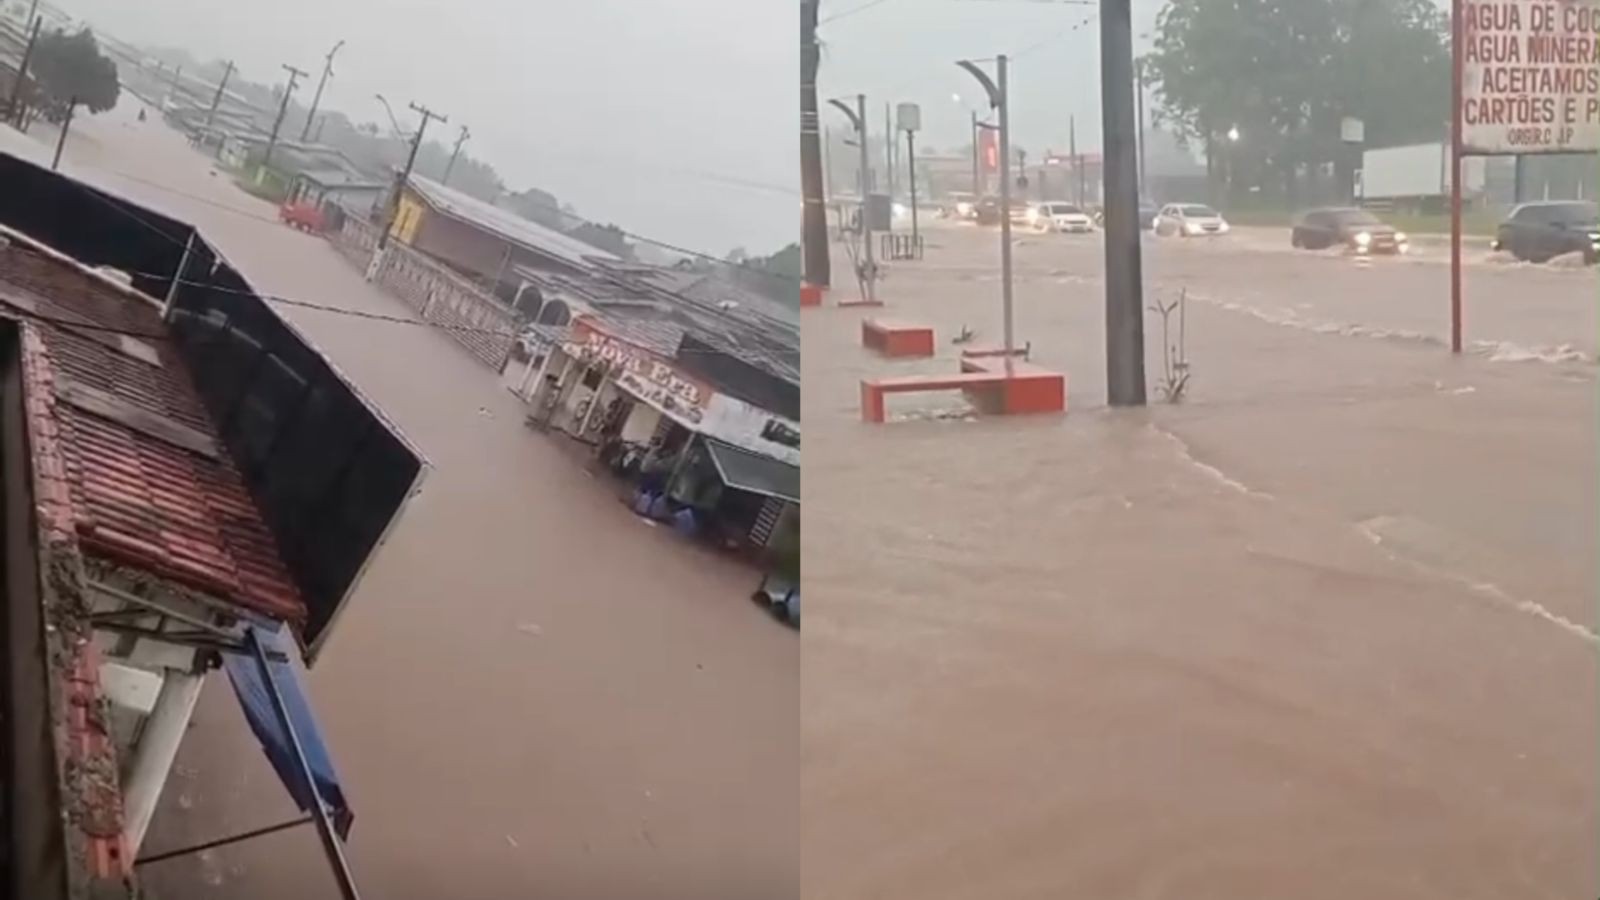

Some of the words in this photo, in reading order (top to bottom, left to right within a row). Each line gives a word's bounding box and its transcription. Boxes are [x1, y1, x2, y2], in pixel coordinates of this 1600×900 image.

[1466, 4, 1521, 31] AGUA
[1530, 5, 1554, 32] DE
[1466, 35, 1520, 63] AGUA
[1482, 68, 1598, 93] ACEITAMOS
[1465, 94, 1555, 125] CARTÕES
[1565, 98, 1576, 123] E
[1586, 98, 1600, 124] P
[649, 361, 700, 404] Era
